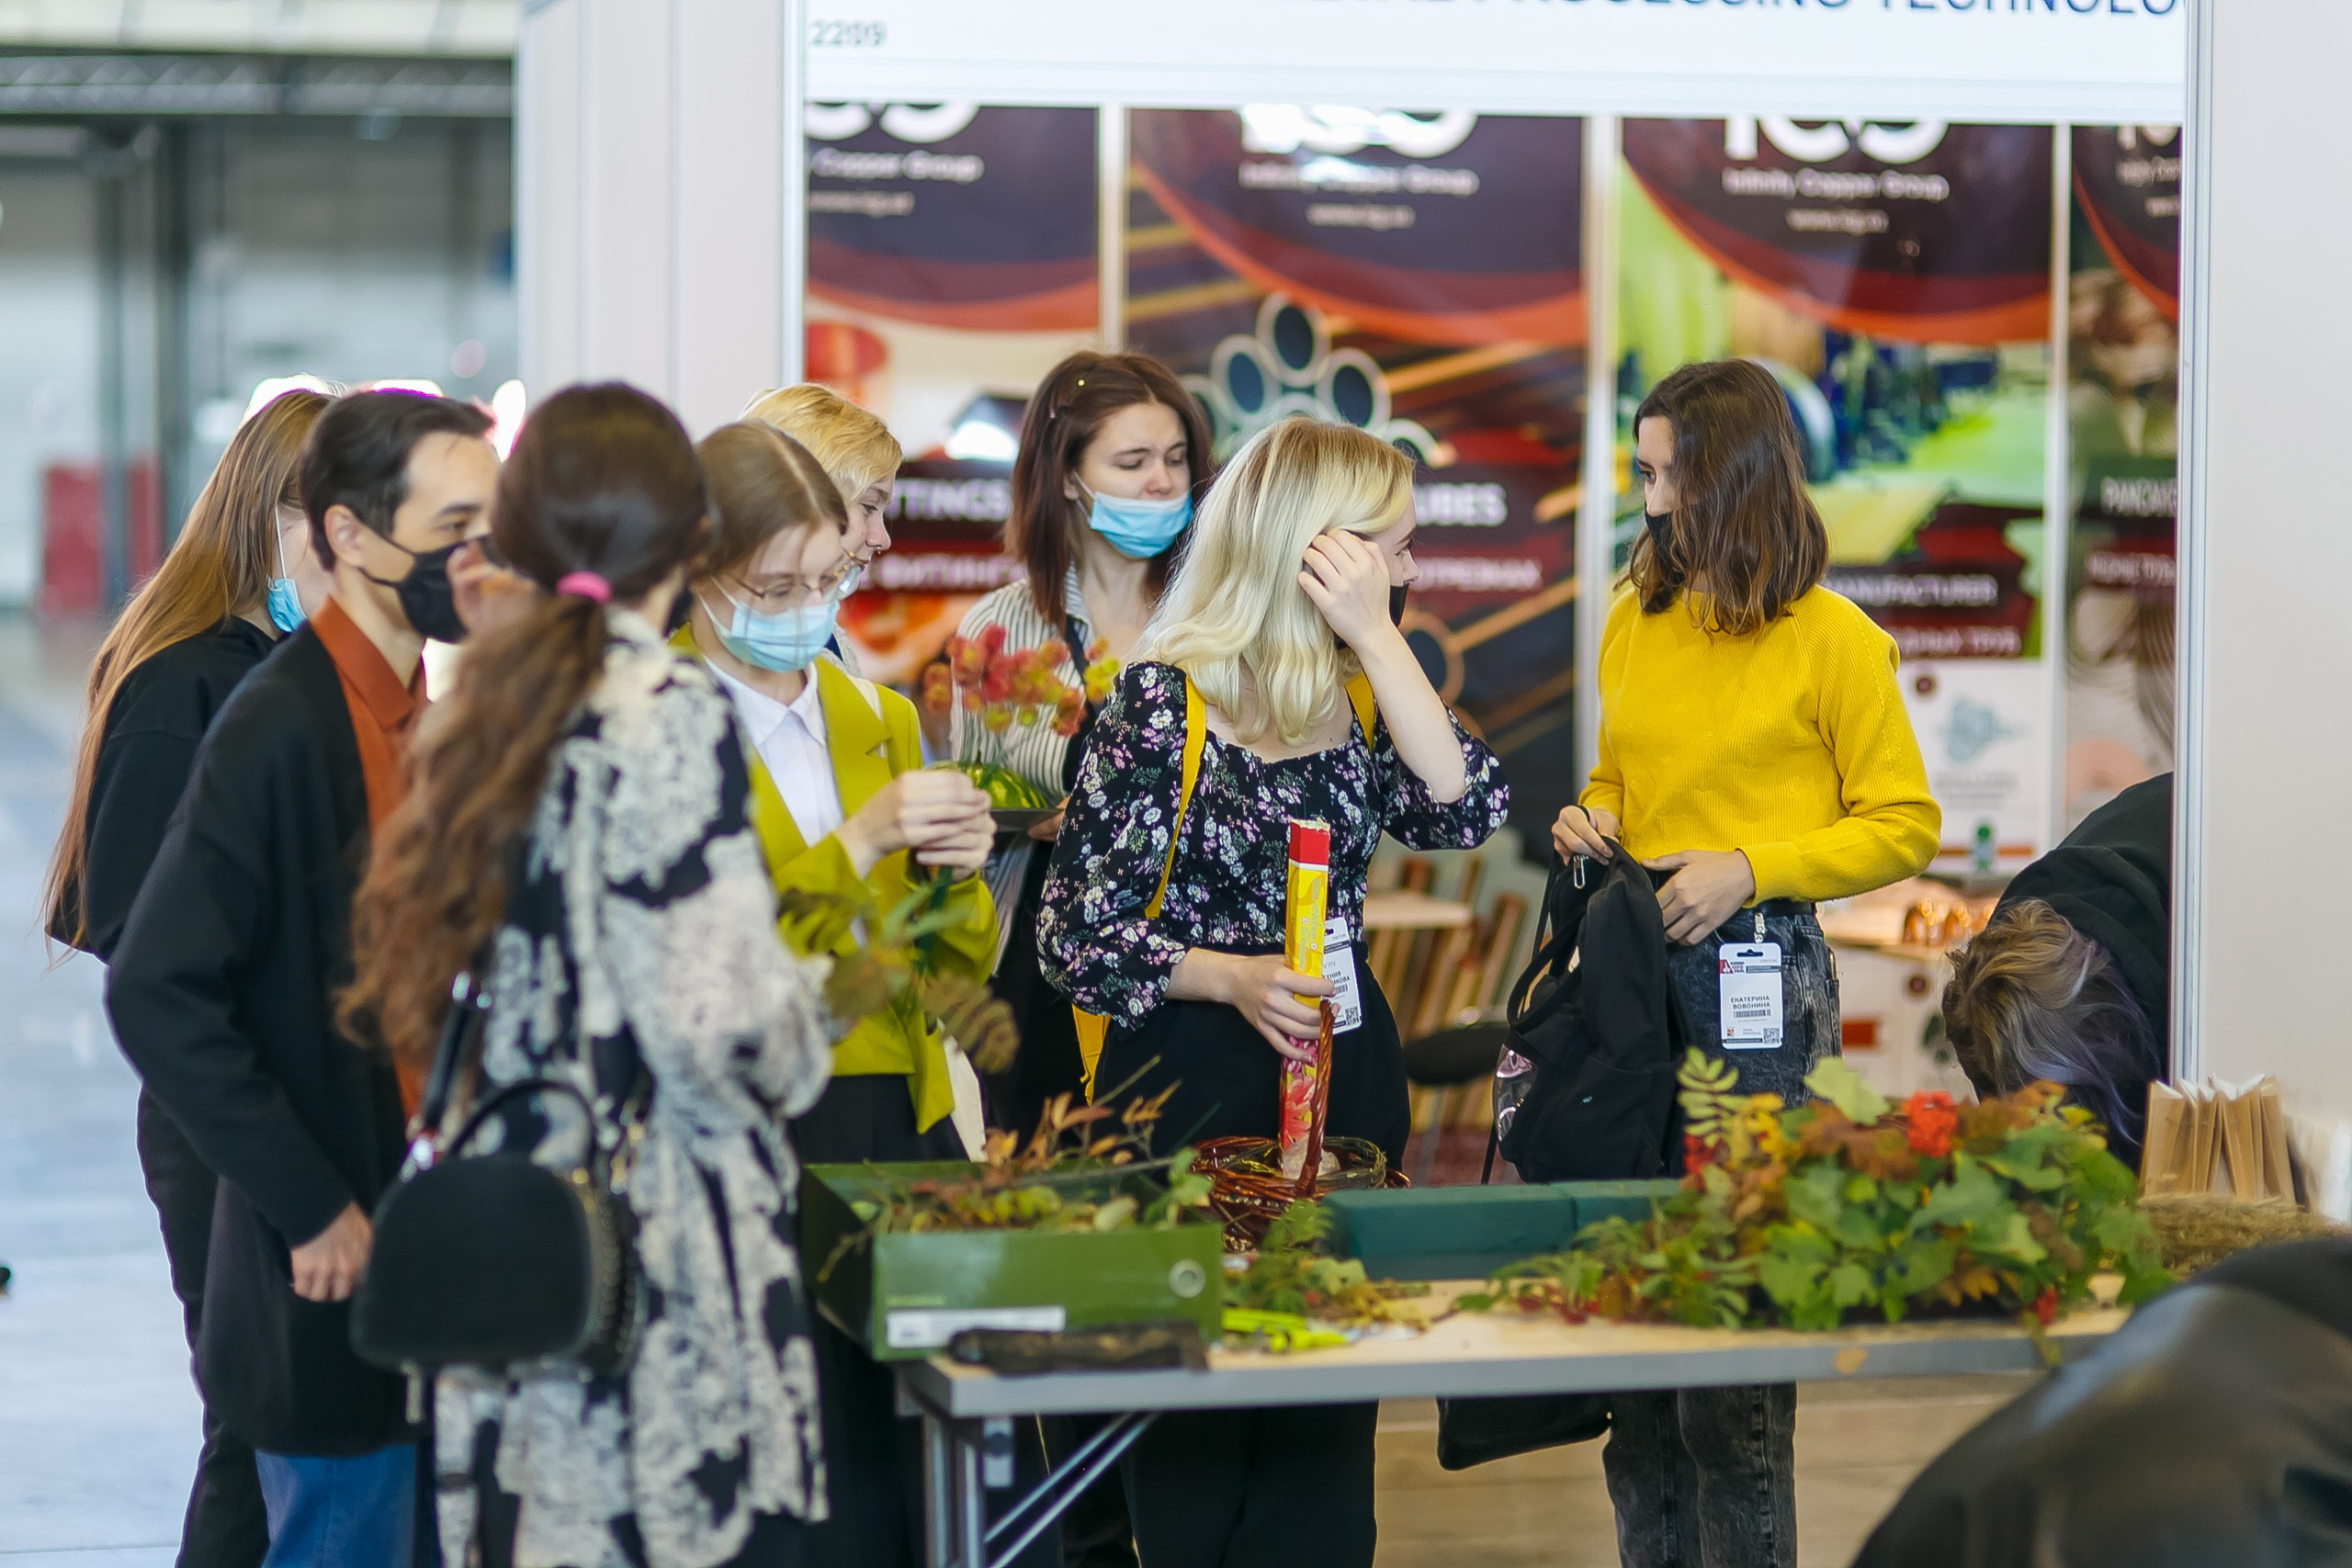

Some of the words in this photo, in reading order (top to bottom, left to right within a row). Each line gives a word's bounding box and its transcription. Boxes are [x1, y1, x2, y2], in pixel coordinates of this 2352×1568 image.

[883, 478, 1012, 521] TTINGS
[1413, 482, 1510, 527] UBES
[1730, 995, 1770, 1004] ЕКАТЕРИНА
